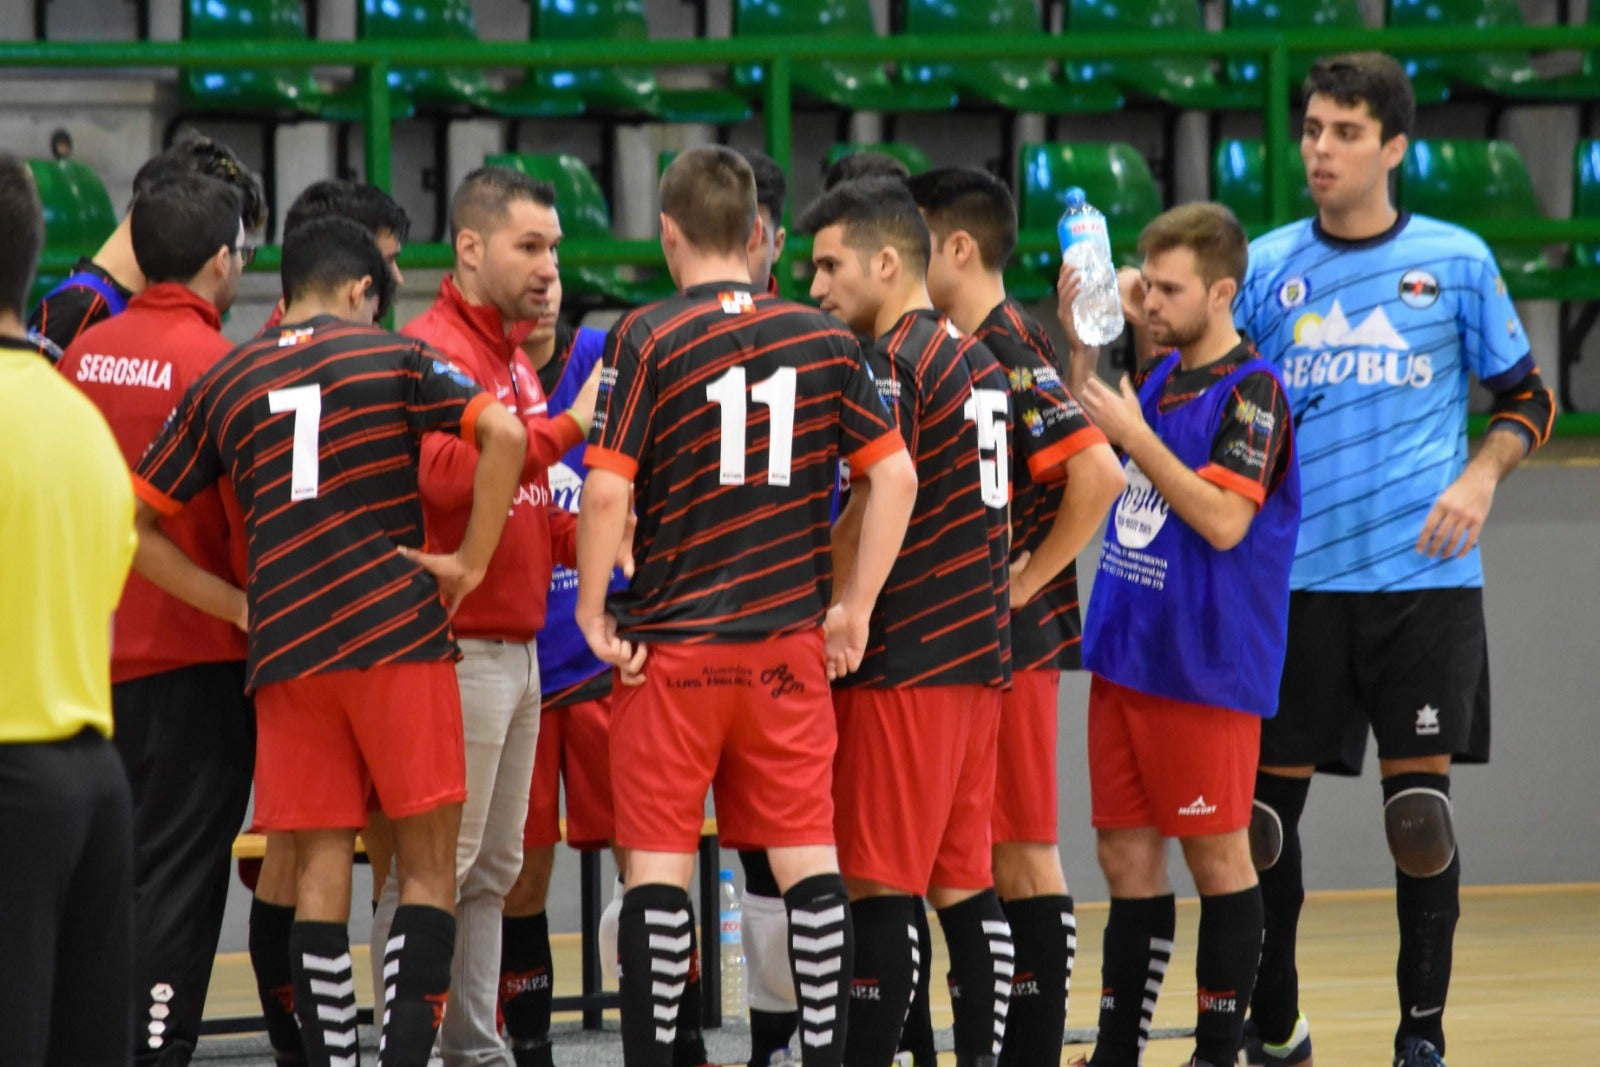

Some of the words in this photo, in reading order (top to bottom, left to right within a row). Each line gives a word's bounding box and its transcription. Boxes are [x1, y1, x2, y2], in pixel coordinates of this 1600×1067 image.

[76, 352, 173, 391] SEGOSALA
[706, 365, 797, 487] 11
[268, 383, 322, 502] 7
[964, 388, 1009, 509] 15
